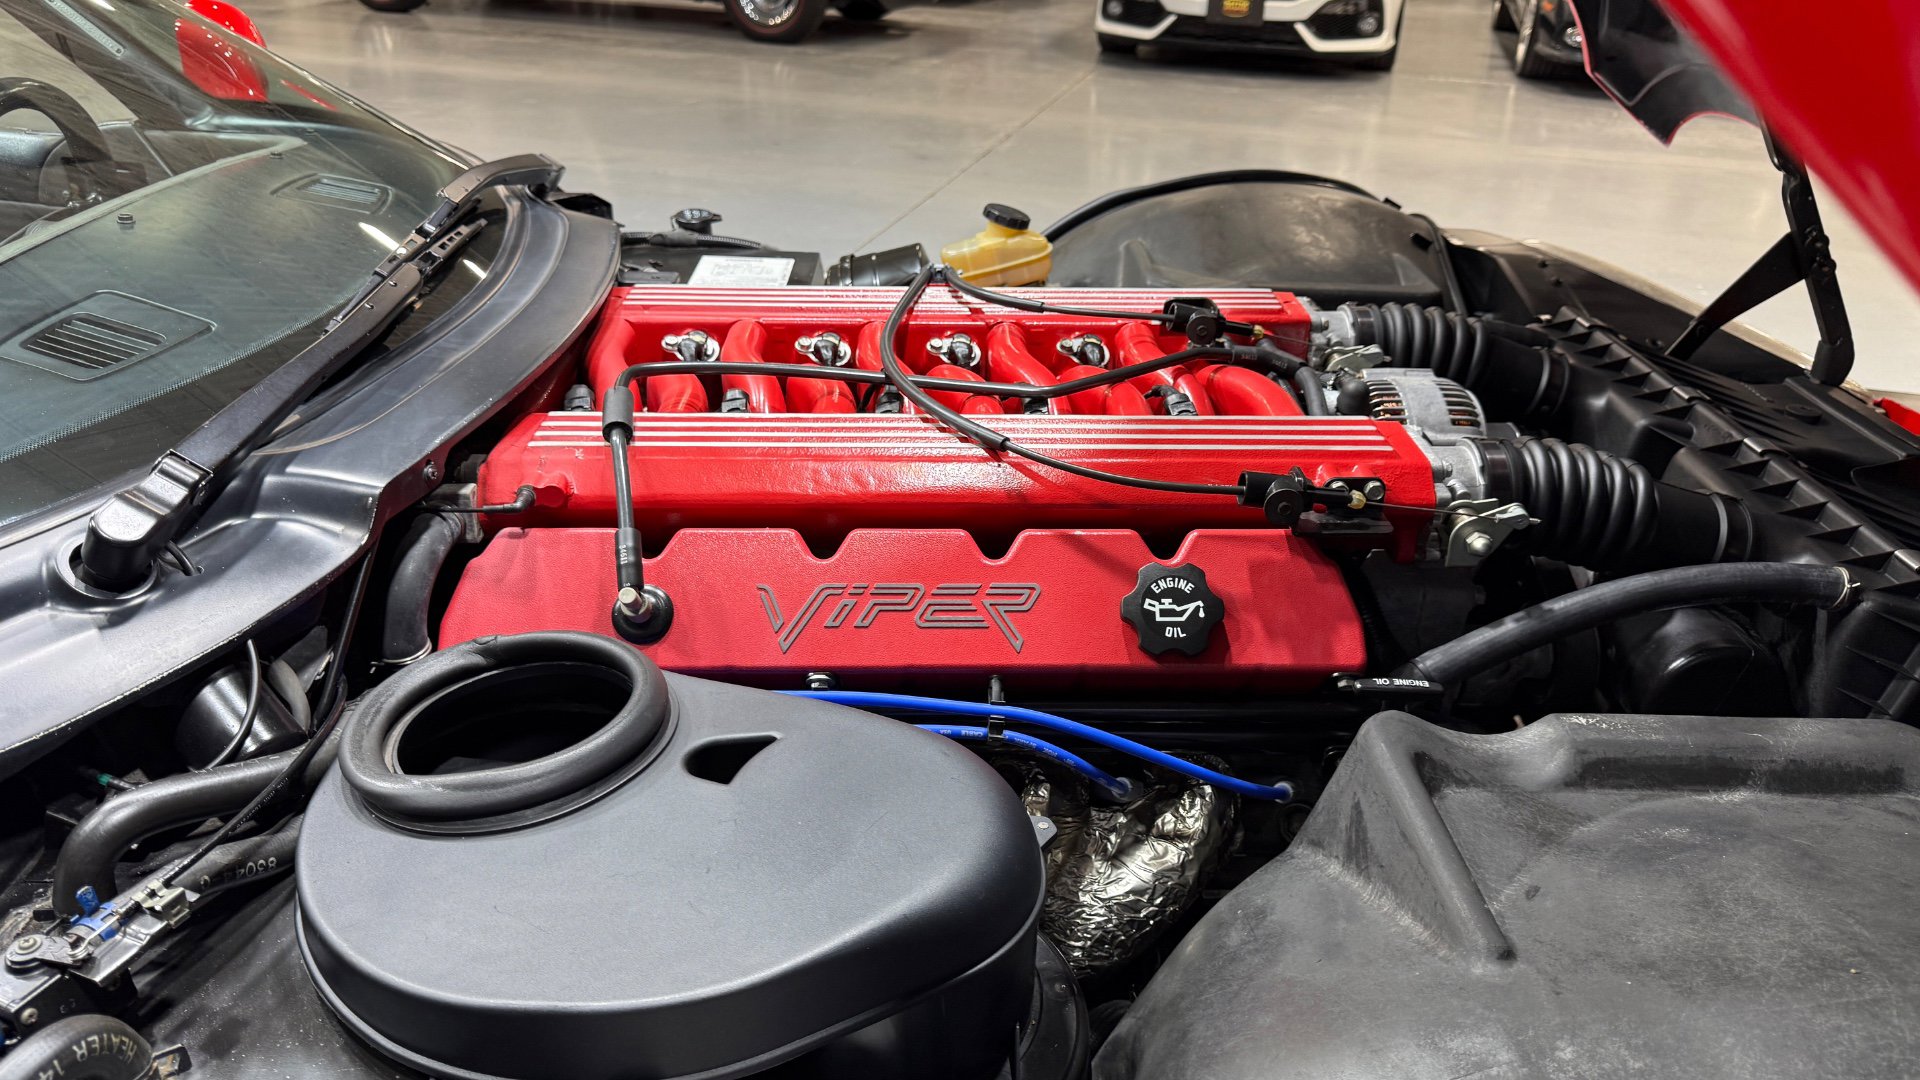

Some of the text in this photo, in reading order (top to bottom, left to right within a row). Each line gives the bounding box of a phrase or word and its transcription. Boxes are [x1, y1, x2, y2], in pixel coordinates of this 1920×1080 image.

[1151, 577, 1195, 594] ENGINE
[1165, 626, 1187, 638] OIL
[1372, 678, 1430, 688] ENGINE OIL
[72, 1033, 138, 1063] HEATER
